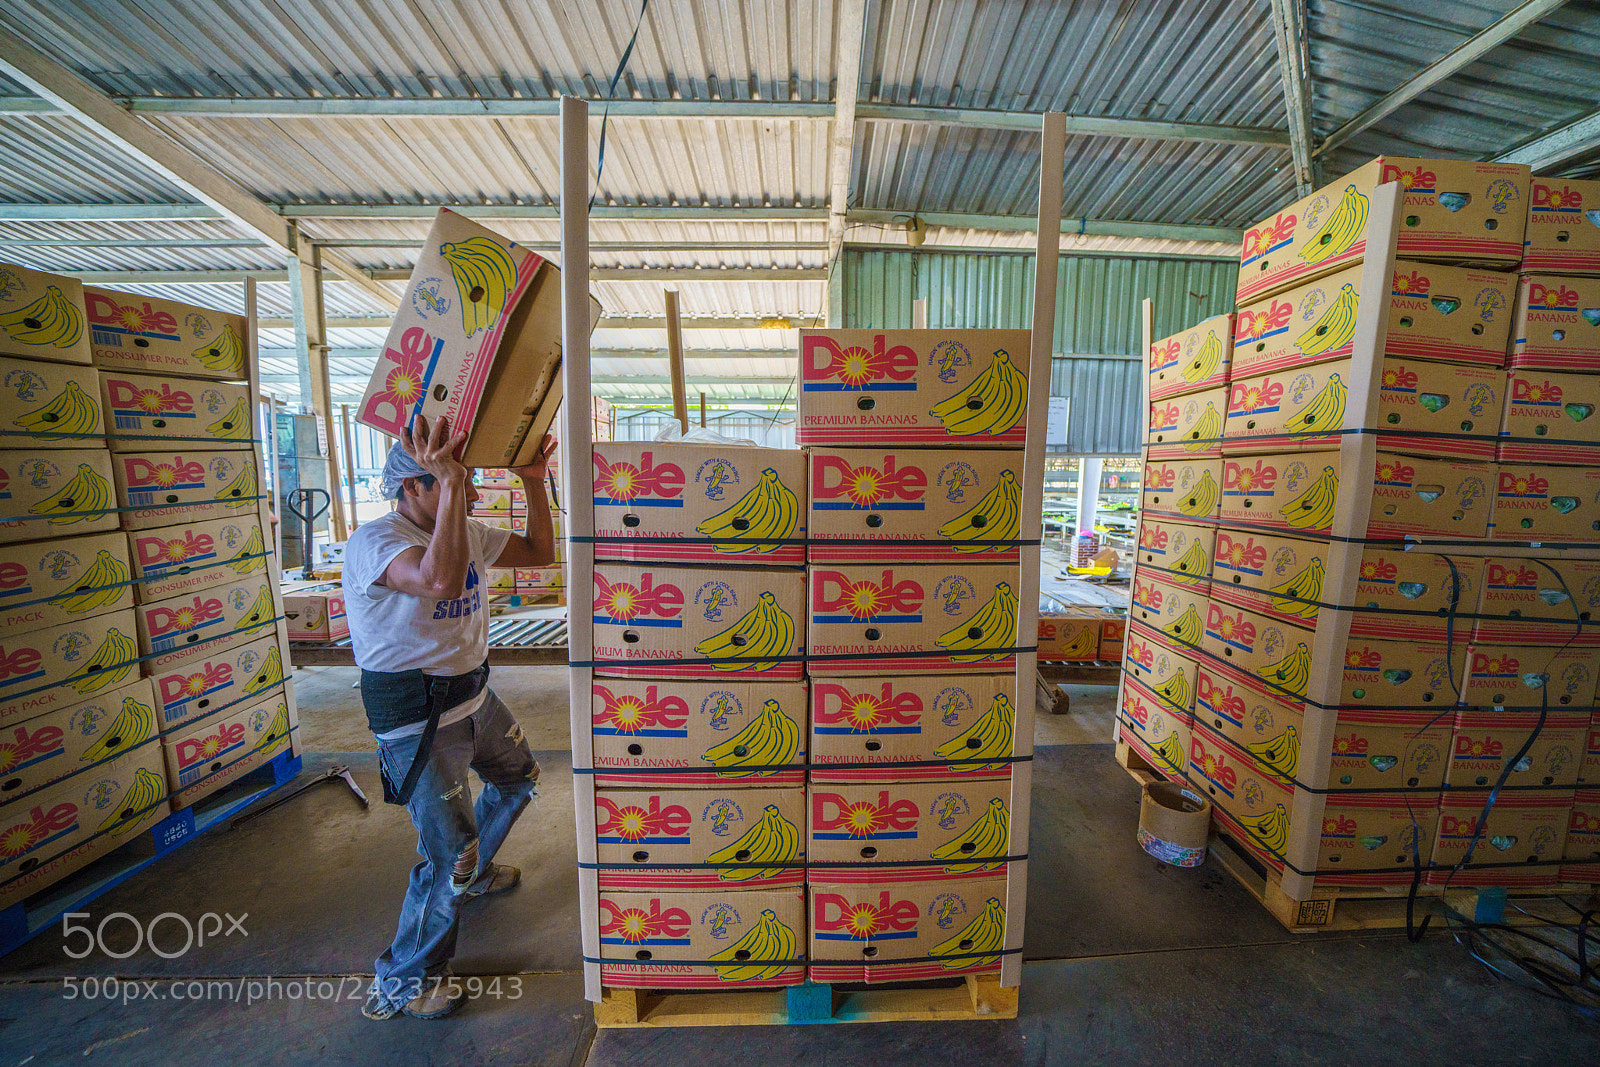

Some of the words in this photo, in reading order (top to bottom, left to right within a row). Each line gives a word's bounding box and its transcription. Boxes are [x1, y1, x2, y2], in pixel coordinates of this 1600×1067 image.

[1404, 197, 1435, 206] ANAS
[1532, 184, 1583, 208] Dole
[1531, 214, 1582, 225] BANANAS
[1242, 213, 1297, 262] Dole
[1260, 260, 1291, 280] BANANAS
[1393, 271, 1431, 294] ole
[1391, 299, 1428, 311] NANAS
[1528, 283, 1579, 308] Dole
[83, 292, 178, 333] Dole
[1236, 299, 1293, 341] Dole
[1527, 313, 1578, 324] BANANAS
[96, 350, 163, 364] CONSUMER
[164, 355, 189, 366] PACK
[803, 335, 919, 386] Dole
[1256, 348, 1287, 363] BANANAS
[362, 326, 432, 436] Dole
[452, 351, 475, 411] BANANAS
[1382, 366, 1418, 388] ole
[106, 379, 195, 414] Dole
[1228, 377, 1284, 412] Dole
[1379, 394, 1416, 405] NANAS
[1512, 379, 1563, 404] Dole
[804, 415, 857, 425] PREMIUM
[860, 415, 918, 425] BANANAS
[1510, 408, 1561, 419] BANANAS
[1246, 427, 1277, 437] BANANAS
[124, 456, 205, 487] Dole
[813, 455, 928, 505] Dole
[1223, 459, 1278, 493] Dole
[1375, 461, 1415, 482] ole
[1373, 488, 1411, 499] NANAS
[1499, 472, 1549, 495] Dole
[134, 504, 191, 519] CONSUMER
[192, 502, 215, 514] PACK
[1243, 511, 1273, 519] BANANAS
[1497, 500, 1548, 510] BANANAS
[0, 517, 27, 528] ACK
[594, 530, 624, 538] MIUM
[626, 530, 684, 538] BANANAS
[135, 530, 216, 562] Dole
[1215, 533, 1267, 569] Dole
[516, 571, 541, 580] Dole
[1360, 558, 1397, 581] ole
[1488, 564, 1539, 587] Dole
[146, 577, 200, 596] CONSUMER
[201, 571, 225, 584] PACK
[813, 570, 925, 618] Dole
[1357, 584, 1394, 595] NANAS
[329, 598, 346, 616] Do
[1486, 592, 1536, 602] BANANAS
[7, 611, 44, 626] PACK
[145, 597, 225, 634] Dole
[1206, 603, 1257, 646] Dole
[1037, 621, 1056, 638] le
[1103, 622, 1124, 640] Do
[156, 642, 209, 666] CONSUMER
[210, 634, 234, 650] PACK
[593, 646, 624, 657] MIUM
[626, 648, 683, 659] BANANAS
[813, 645, 865, 654] PREMIUM
[868, 644, 923, 653] BANANAS
[1346, 647, 1381, 669] ole
[0, 645, 42, 680] le
[1471, 653, 1520, 675] Dole
[158, 661, 235, 705] Dole
[1342, 672, 1379, 683] NANAS
[1470, 680, 1517, 689] BANANAS
[22, 693, 57, 711] PACK
[814, 683, 924, 729] Dole
[1198, 671, 1246, 720] Dole
[0, 726, 64, 775] ole
[175, 721, 246, 769] Dole
[1333, 734, 1369, 753] ole
[1455, 736, 1503, 757] Dole
[234, 756, 253, 772] PACK
[593, 756, 630, 767] EMIUM
[633, 757, 689, 768] BANANAS
[815, 755, 865, 764] PREMIUM
[868, 754, 922, 763] BANANAS
[1190, 734, 1237, 790] Dole
[1332, 759, 1366, 768] NANAS
[1453, 762, 1501, 771] BANANAS
[813, 791, 920, 835] Dole
[1571, 812, 1600, 832] Dol
[0, 805, 78, 857] ole
[1323, 815, 1357, 835] ole
[1320, 839, 1355, 849] NANAS
[1569, 836, 1600, 845] BANAN
[0, 859, 60, 896] NSUMER
[815, 891, 920, 937] Dole
[602, 963, 637, 972] EMIUM
[640, 963, 693, 973] BANANAS
